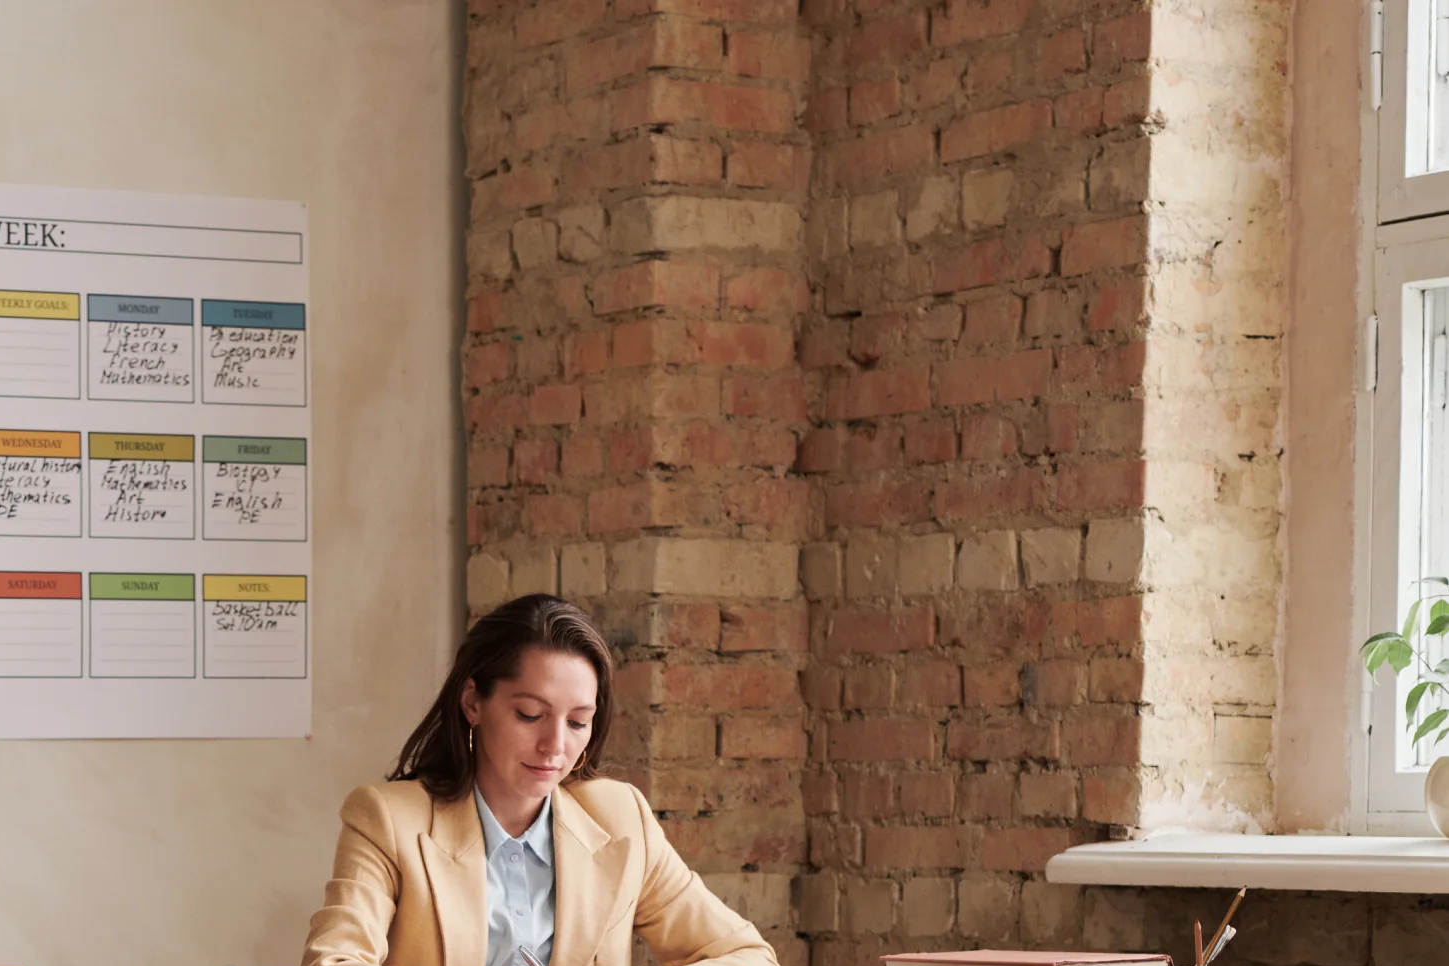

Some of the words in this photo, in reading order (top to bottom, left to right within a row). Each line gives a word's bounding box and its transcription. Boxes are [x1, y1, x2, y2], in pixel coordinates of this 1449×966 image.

[117, 303, 161, 316] MONDAY
[232, 308, 274, 321] TUESDAY
[107, 322, 166, 338] History
[229, 328, 298, 345] education
[103, 337, 178, 353] Literacy
[211, 342, 296, 362] Geography
[100, 370, 191, 387] Mathematics
[213, 371, 260, 388] Music
[1, 437, 63, 449] WEDNESDAY
[114, 440, 166, 452] THURSDAY
[237, 444, 272, 455] FRIDAY
[106, 458, 171, 478] English
[101, 474, 188, 492] Mathematics
[116, 489, 145, 505] Art
[211, 491, 283, 512] English
[105, 505, 167, 523] History
[238, 509, 261, 524] PE
[8, 578, 58, 591] SATURDAY
[121, 580, 161, 593] SUNDAY
